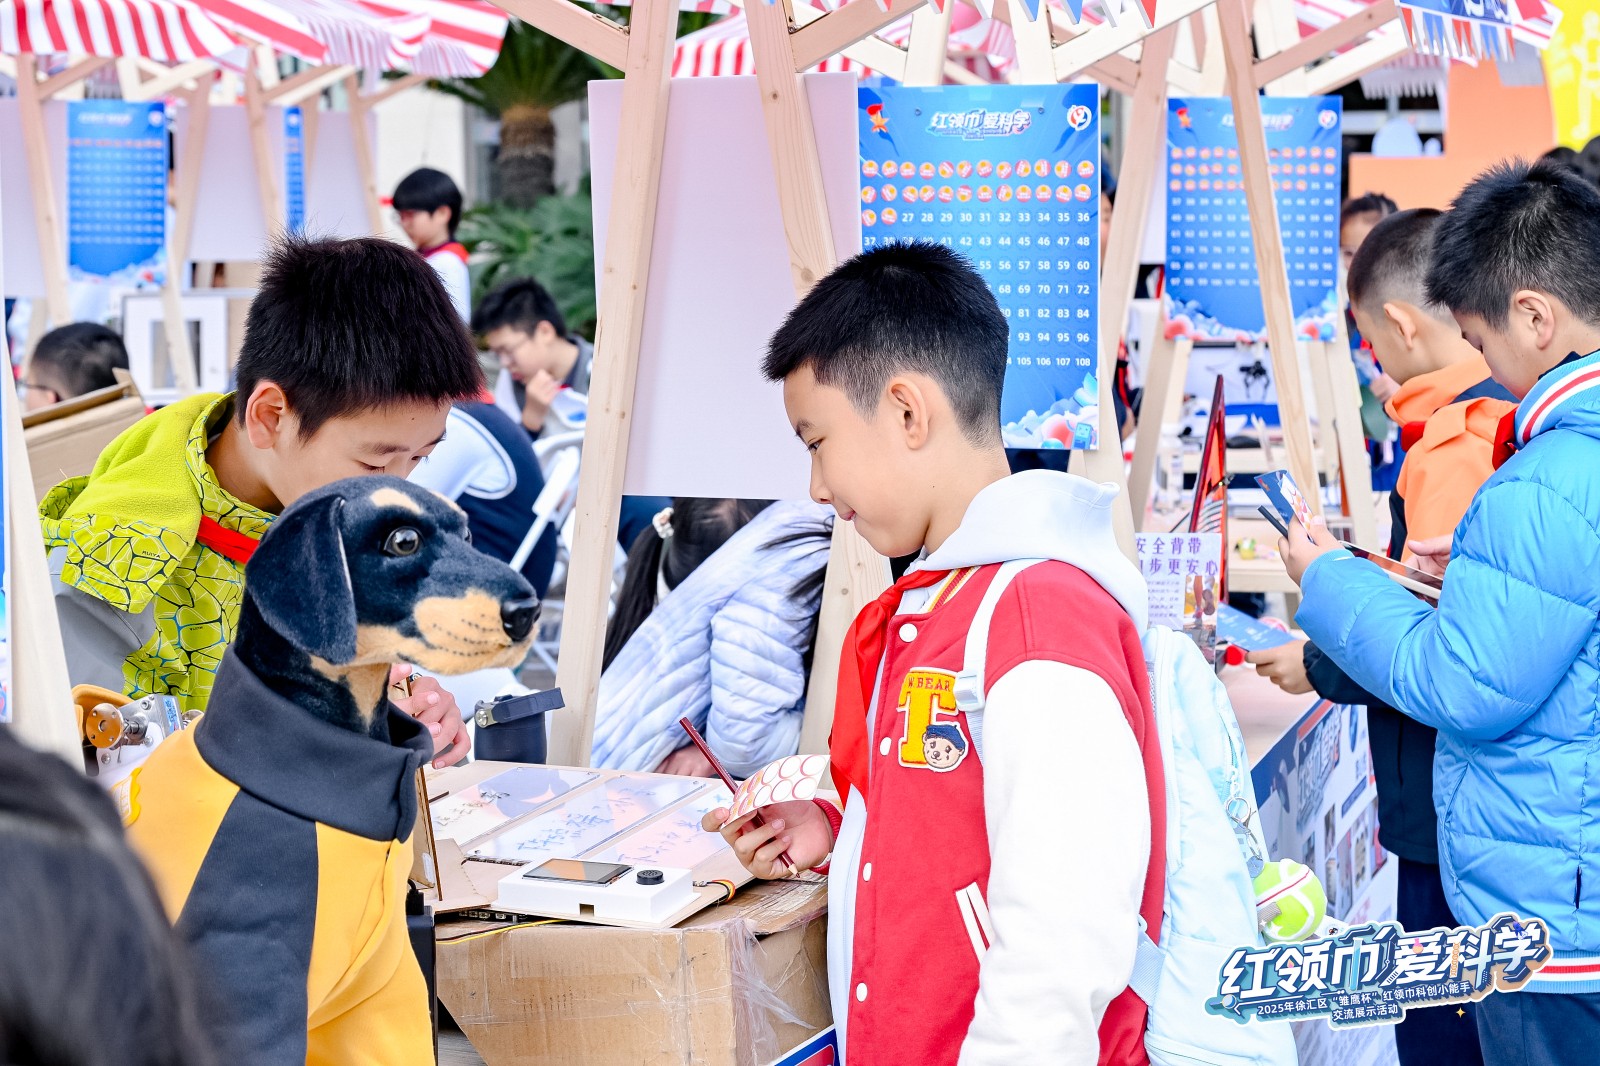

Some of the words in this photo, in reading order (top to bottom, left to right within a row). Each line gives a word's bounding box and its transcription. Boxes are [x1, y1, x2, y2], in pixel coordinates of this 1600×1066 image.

[931, 111, 1031, 133] 红领巾爱科学
[901, 212, 915, 223] 27
[921, 212, 934, 223] 28
[940, 212, 954, 223] 29
[959, 212, 973, 223] 30
[979, 212, 991, 223] 31
[998, 212, 1011, 223] 32
[1018, 212, 1031, 223] 33
[1037, 212, 1051, 223] 34
[1057, 212, 1071, 223] 35
[1077, 212, 1090, 223] 36
[864, 236, 876, 247] 37
[959, 236, 973, 247] 42
[978, 236, 992, 247] 43
[998, 236, 1012, 247] 44
[1017, 236, 1031, 247] 45
[1037, 236, 1051, 247] 46
[1057, 236, 1070, 247] 47
[1076, 236, 1090, 247] 48
[979, 260, 992, 271] 55
[998, 260, 1012, 271] 56
[1018, 260, 1031, 271] 57
[1037, 260, 1051, 271] 58
[1057, 260, 1071, 271] 59
[1076, 260, 1090, 271] 60
[998, 284, 1012, 295] 68
[1017, 284, 1031, 295] 69
[1037, 284, 1051, 295] 70
[1057, 284, 1069, 295] 71
[1076, 284, 1090, 295] 72
[1017, 308, 1030, 319] 81
[1037, 308, 1051, 319] 82
[1056, 308, 1070, 319] 83
[1076, 308, 1090, 319] 84
[1017, 332, 1031, 343] 93
[1037, 332, 1051, 343] 94
[1056, 332, 1070, 343] 95
[1076, 332, 1090, 343] 96
[1016, 356, 1032, 367] 105
[1035, 357, 1052, 368] 106
[1055, 357, 1071, 368] 107
[1074, 357, 1091, 368] 108
[1136, 537, 1202, 555] 安全背带
[1139, 558, 1218, 576] 步更安心
